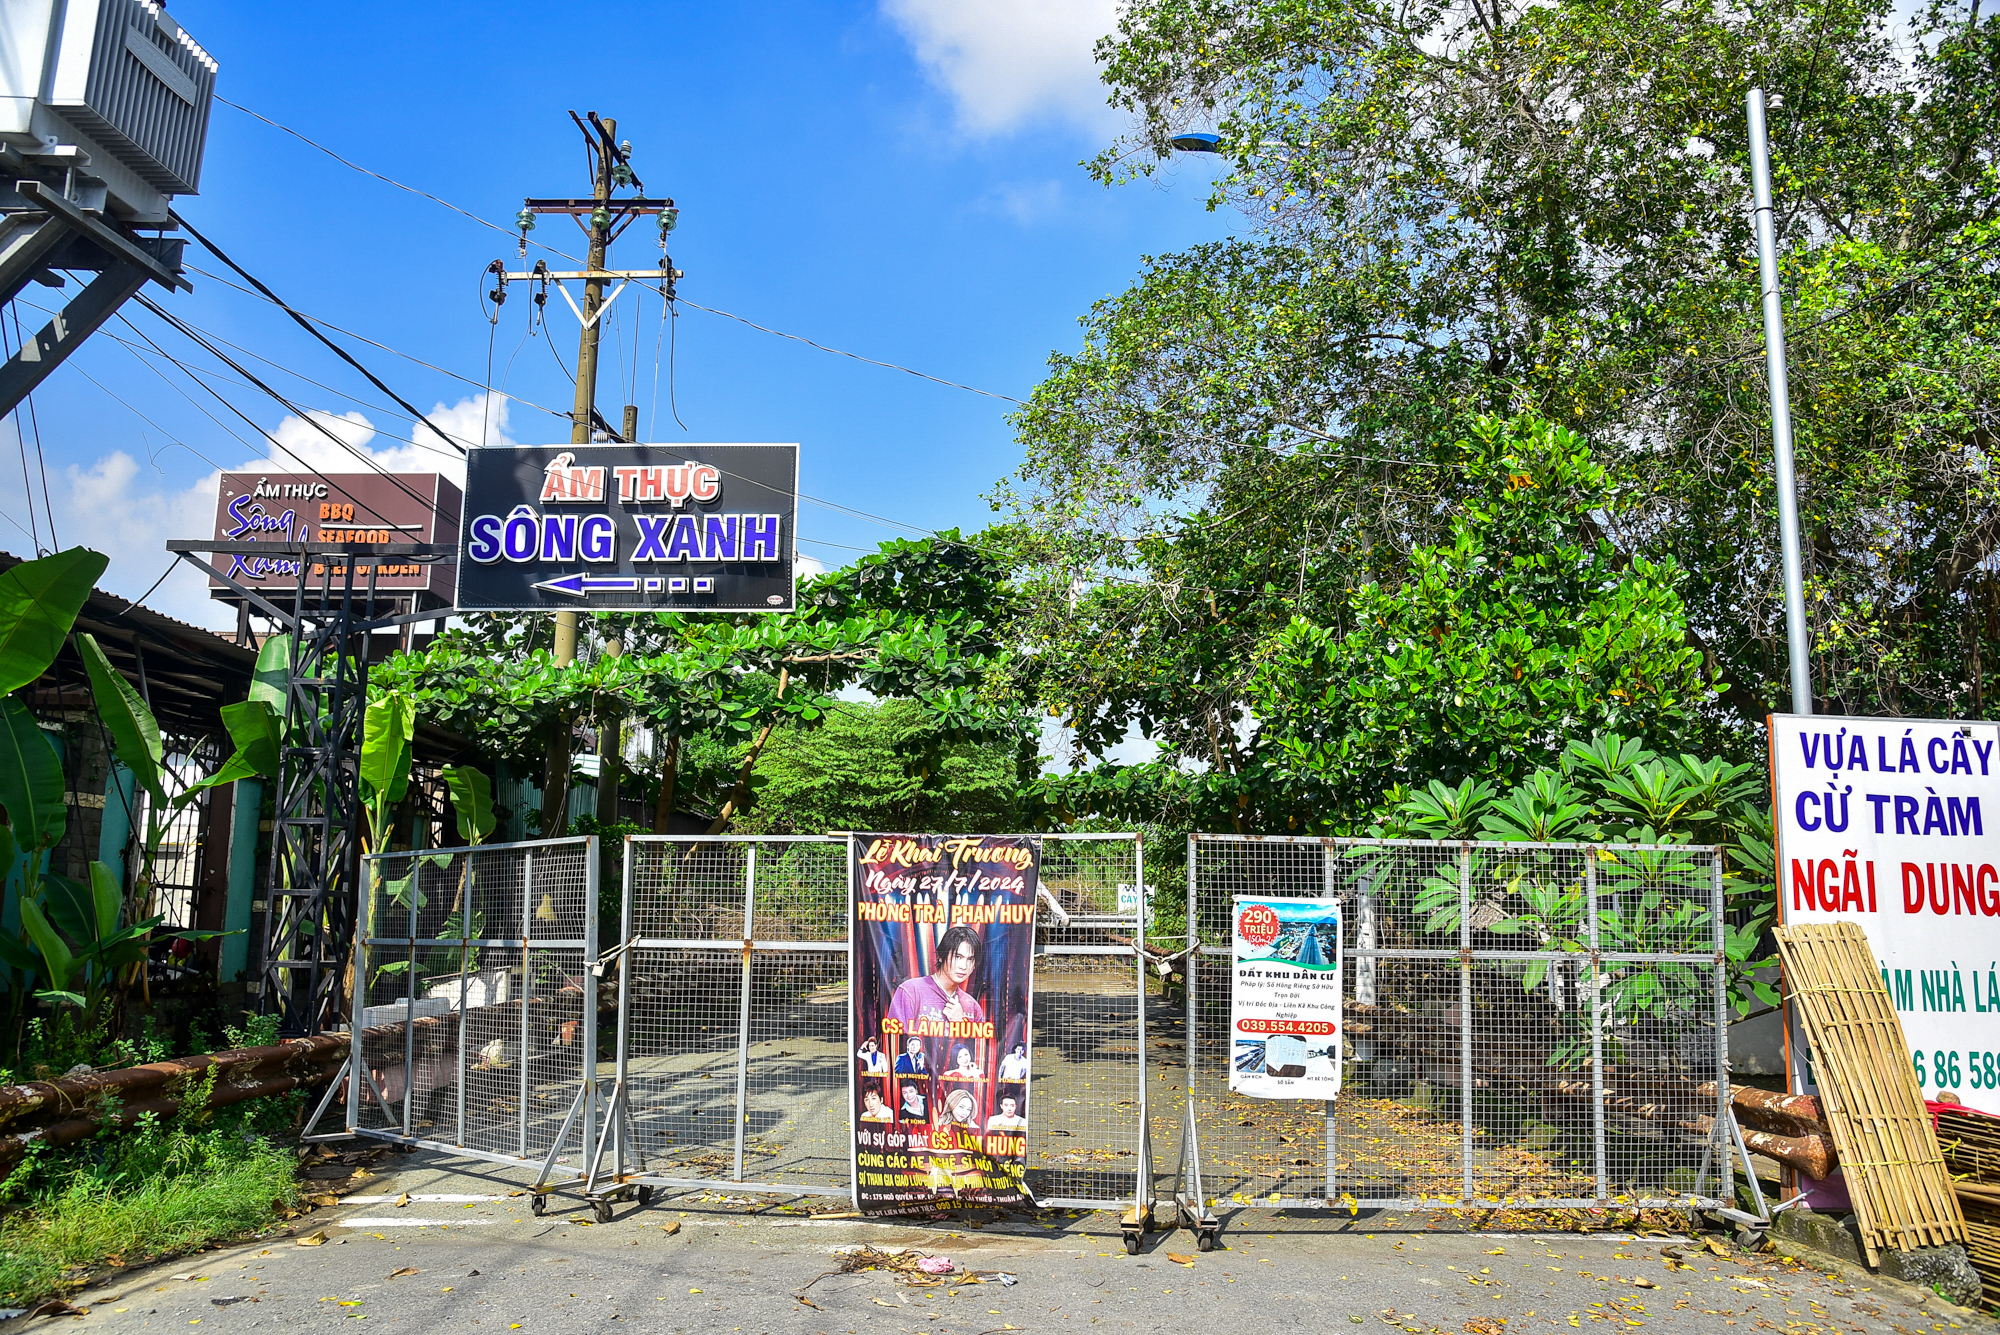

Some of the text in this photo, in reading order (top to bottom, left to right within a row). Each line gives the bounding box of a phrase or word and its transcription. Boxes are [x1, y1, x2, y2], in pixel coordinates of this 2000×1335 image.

[253, 477, 328, 500] ẨM THỰC
[540, 452, 722, 509] ẨM THỰC
[228, 494, 295, 542] Sông
[319, 503, 354, 521] BBQ
[317, 529, 390, 544] SEAFOOD
[468, 505, 781, 563] SÔNG XANH
[1799, 727, 1993, 779] VỰA LÁ CÂY
[1795, 782, 1983, 836] CỪ TRÀM
[889, 839, 944, 867] Khai
[865, 869, 1025, 895] Ngày 27/7/2024
[1791, 849, 2000, 917] NGÃI DUNG
[857, 897, 1034, 925] PHÒNG TRÀ PHAN HUY
[1244, 910, 1271, 924] 290
[1244, 924, 1274, 936] TRIỆU
[1239, 967, 1334, 981] ĐẤT KHU DÂN CƯ
[1920, 960, 1966, 1012] NHÀ
[882, 1017, 994, 1038] CS: LÂM HÙNG
[1241, 1020, 1329, 1033] 039.554.4205
[1934, 1050, 1961, 1088] 86
[857, 1128, 871, 1146] VỚI
[873, 1131, 885, 1148] SỰ
[887, 1131, 906, 1147] GÓP
[931, 1131, 953, 1150] CS:
[956, 1129, 983, 1153] LÂM
[986, 1130, 1026, 1157] HÙNG
[858, 1150, 884, 1167] CÙNG
[886, 1152, 907, 1168] CÁC
[910, 1156, 924, 1169] AE
[961, 1154, 973, 1169] SĨ
[866, 1172, 883, 1186] THAM
[884, 1173, 894, 1186] GIA
[894, 1174, 909, 1186] GIAO
[936, 1201, 950, 1210] 090
[952, 1200, 962, 1209] 15
